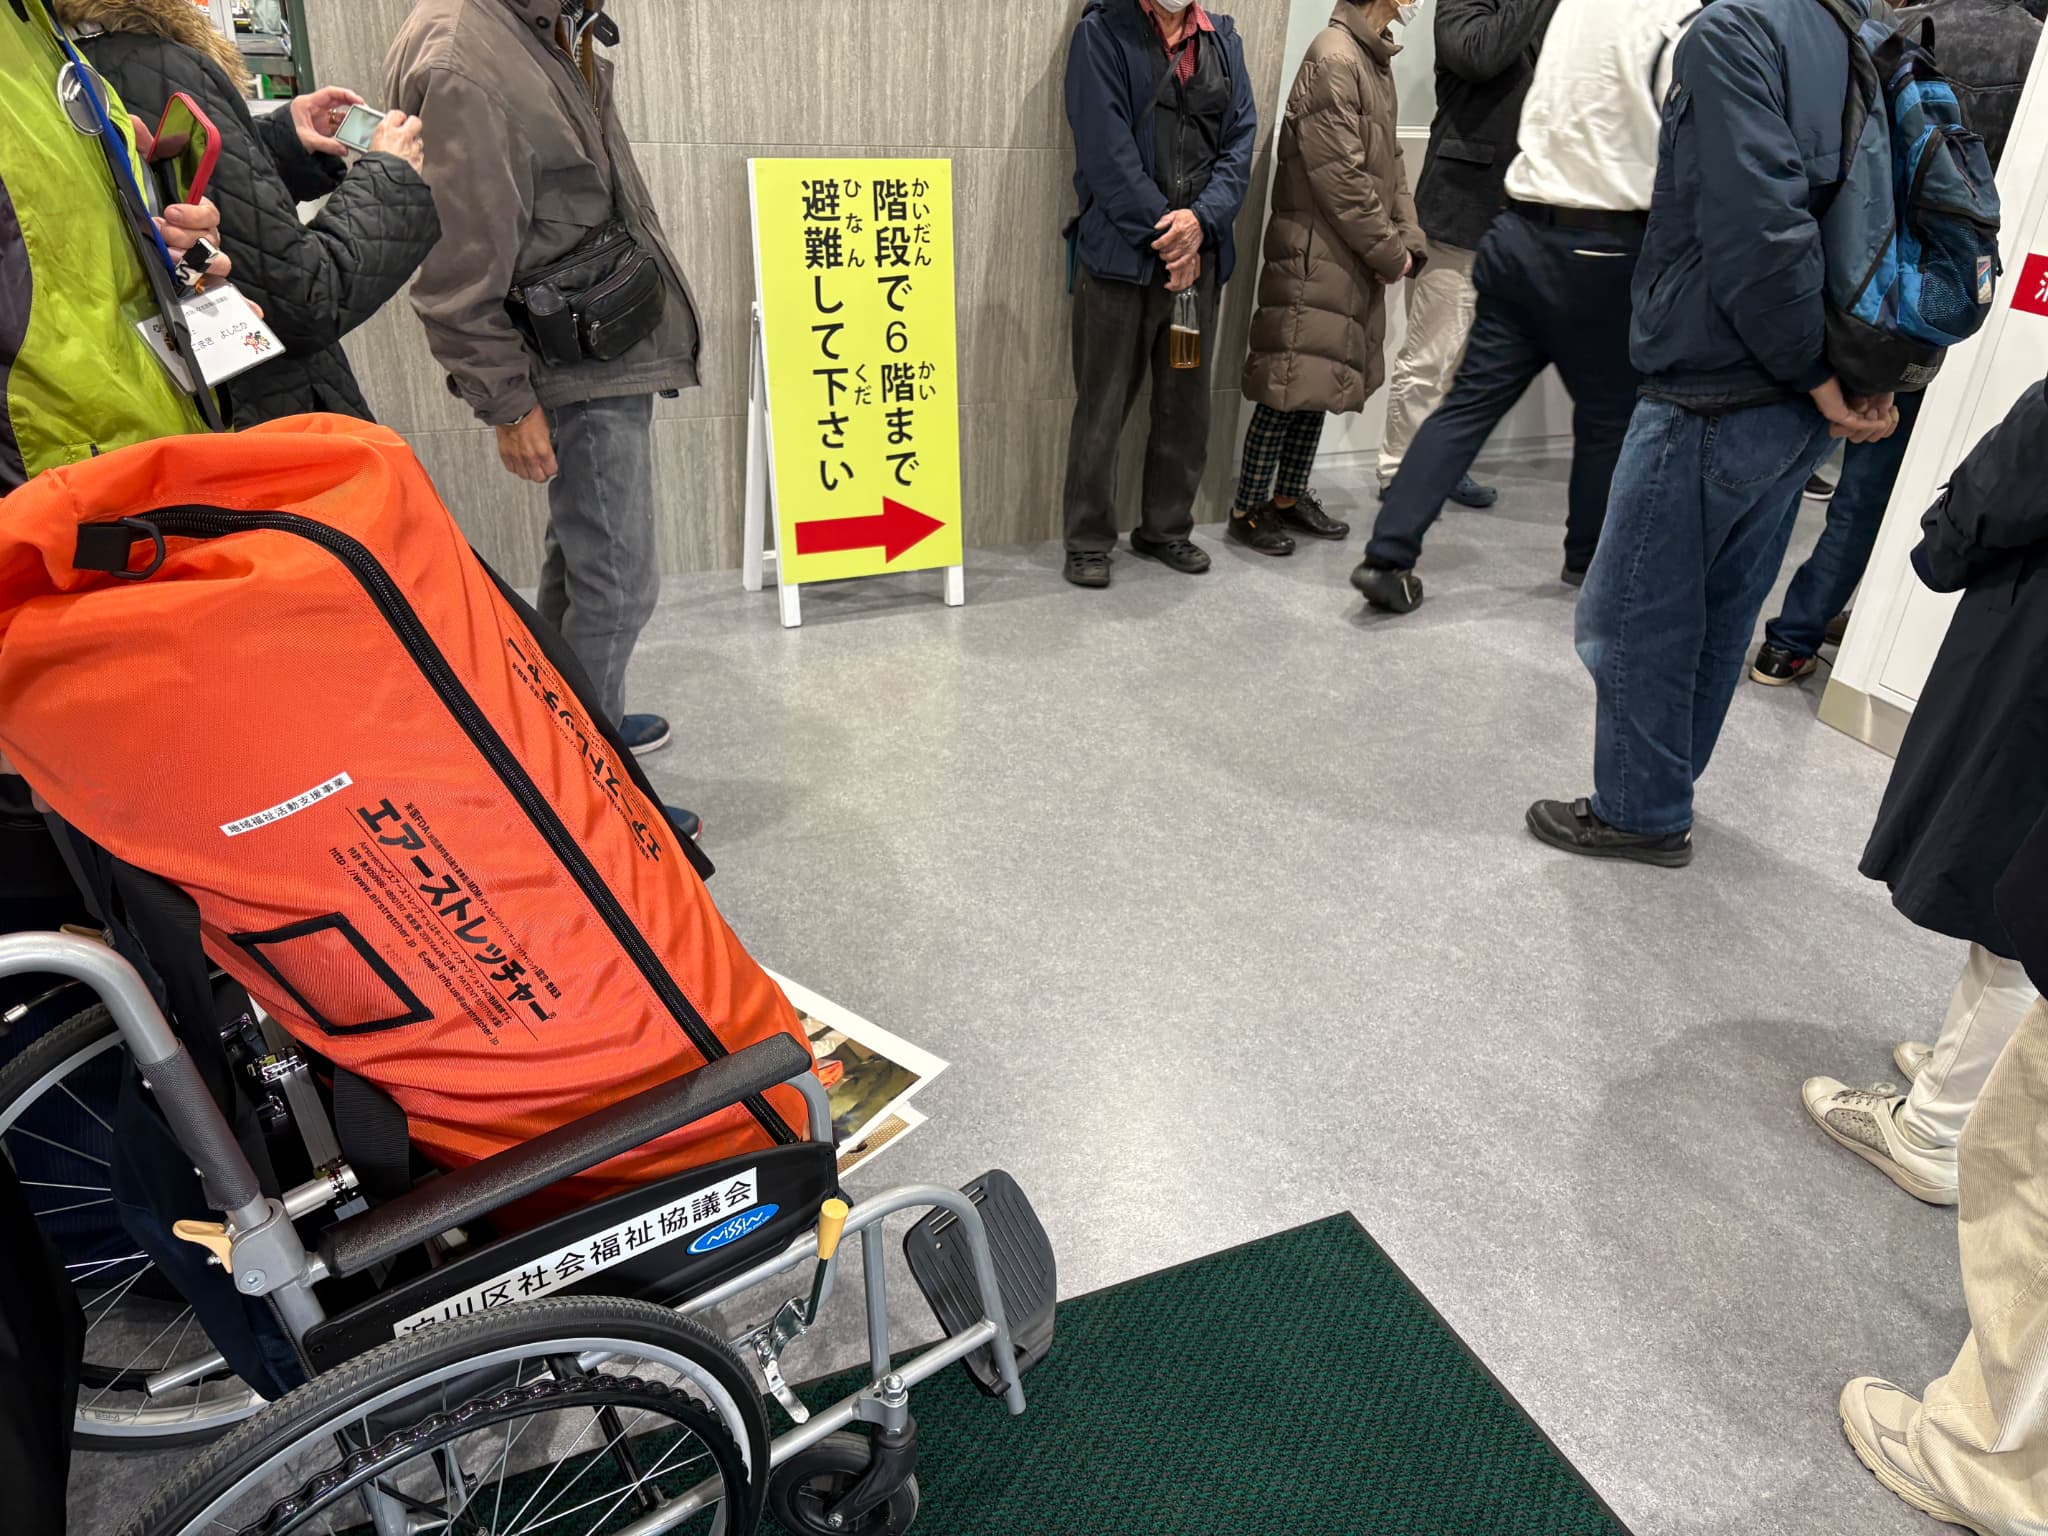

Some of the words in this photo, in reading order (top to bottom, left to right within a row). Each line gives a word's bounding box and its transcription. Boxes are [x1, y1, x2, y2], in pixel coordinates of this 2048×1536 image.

[843, 178, 865, 268] ひなん
[911, 177, 932, 266] かいだん
[801, 178, 854, 491] 避難して下さい
[872, 179, 920, 487] 階段で6階まで
[854, 363, 872, 406] くだ
[918, 360, 936, 401] かい
[228, 777, 345, 834] 地域福祉活動支援事業
[404, 1180, 753, 1331] 川区社会福祉協議会
